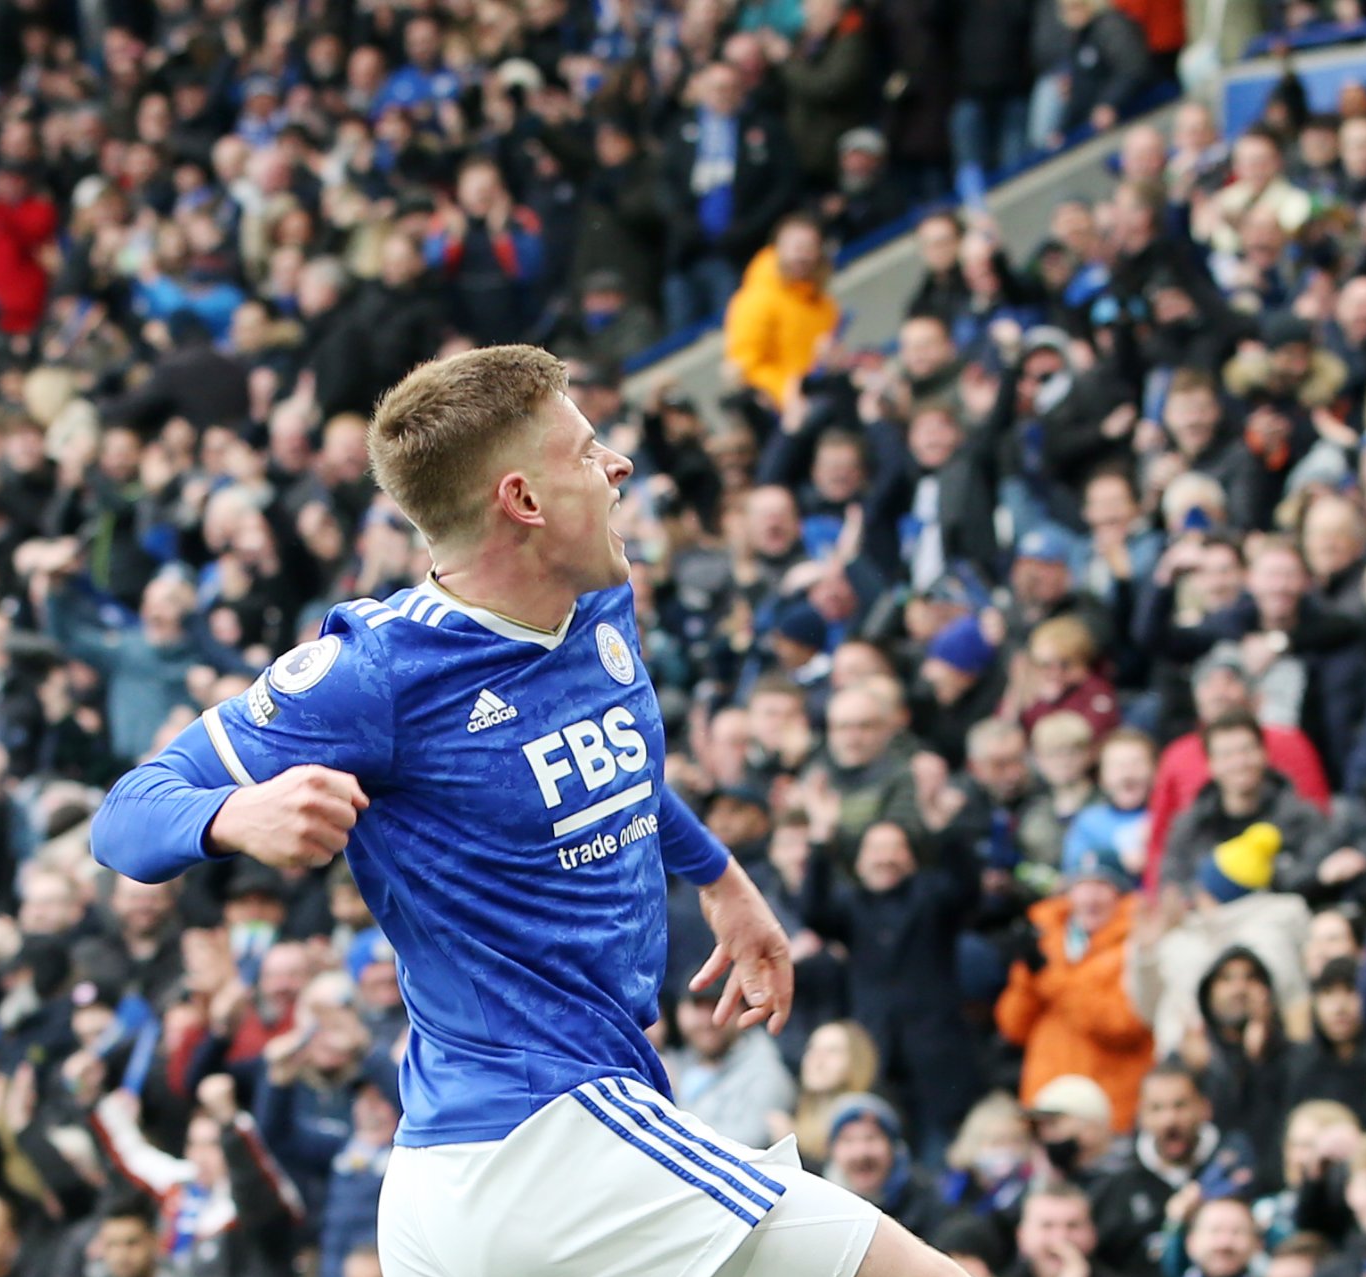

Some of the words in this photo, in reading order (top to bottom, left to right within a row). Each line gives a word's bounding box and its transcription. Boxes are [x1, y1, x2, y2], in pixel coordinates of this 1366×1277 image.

[466, 705, 518, 733] adidas
[521, 706, 648, 809] FBS
[557, 833, 618, 870] trade
[619, 813, 659, 848] online
